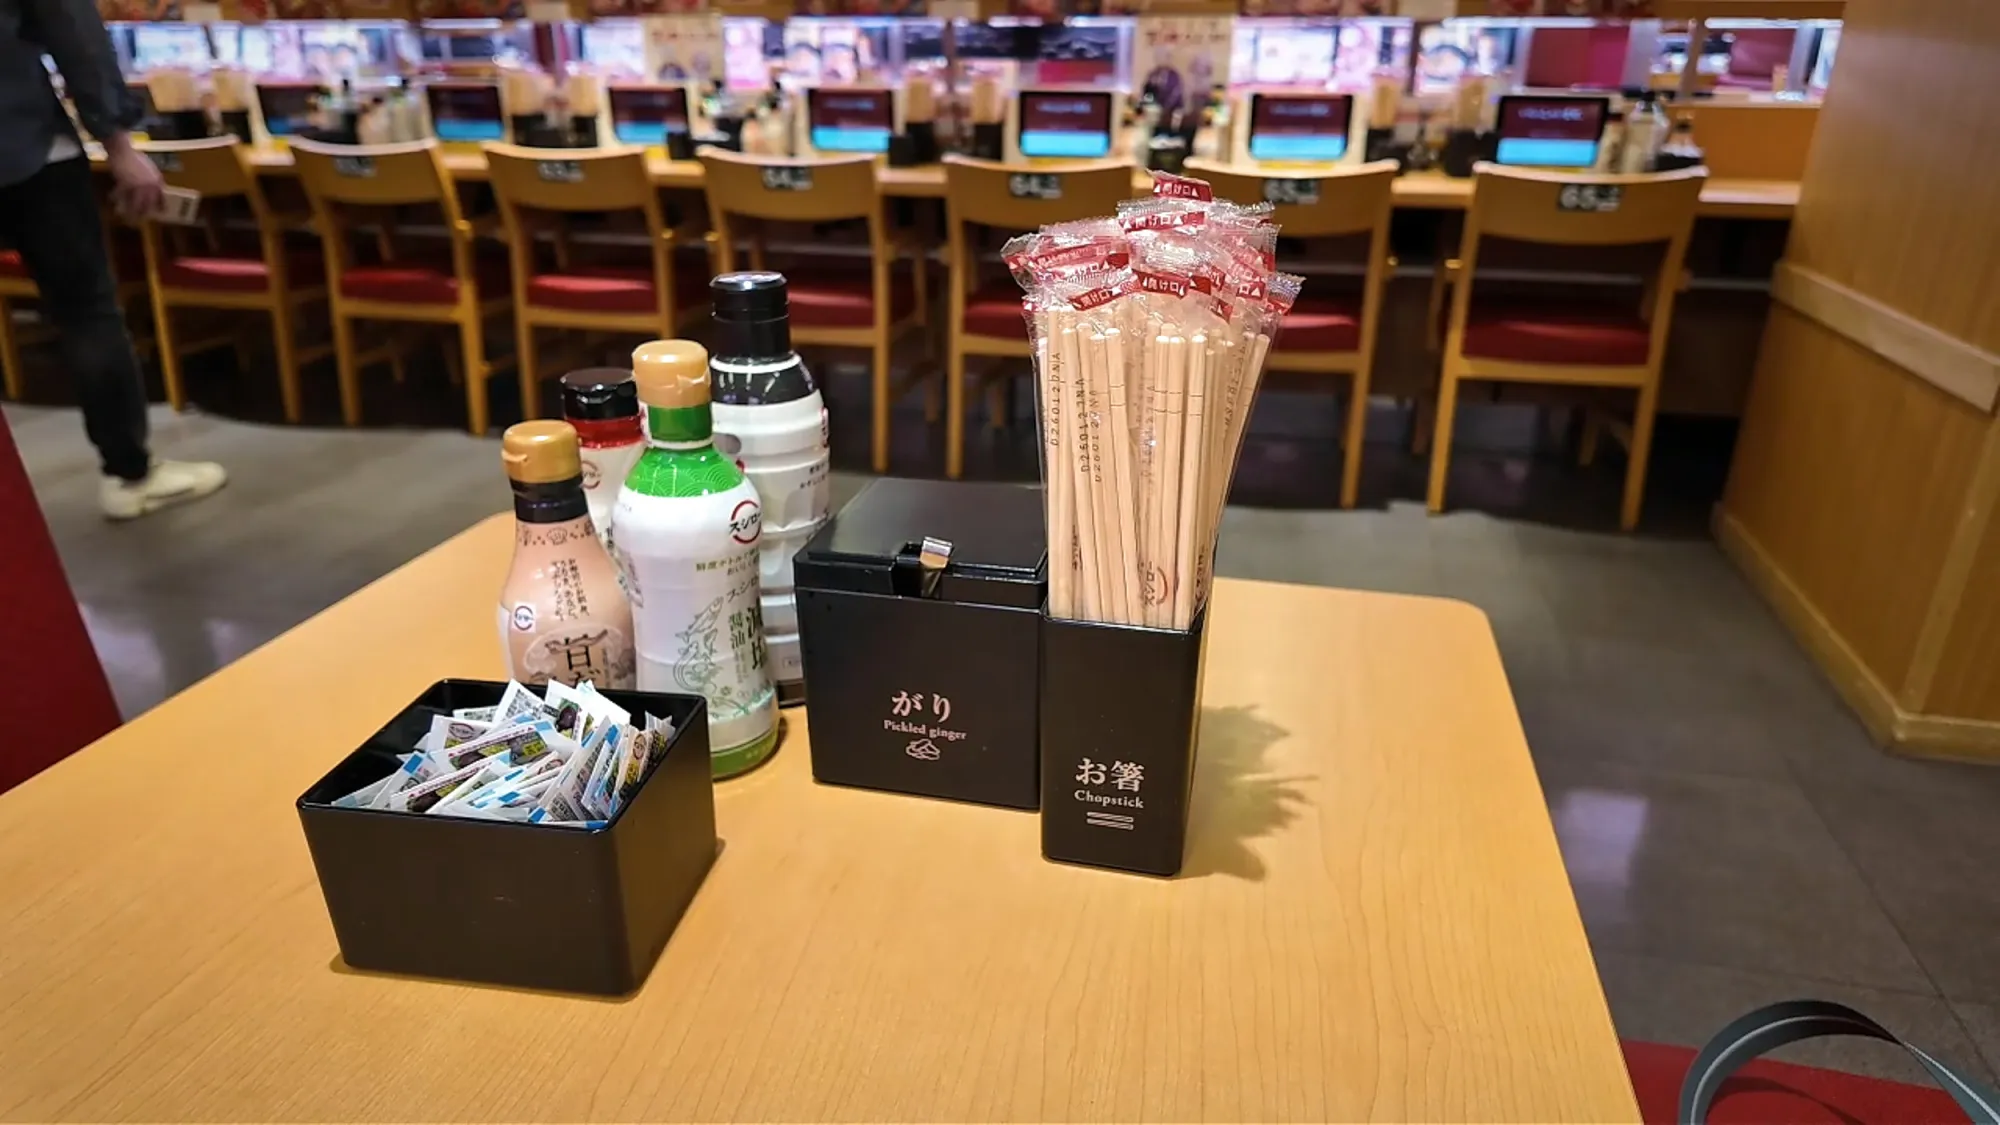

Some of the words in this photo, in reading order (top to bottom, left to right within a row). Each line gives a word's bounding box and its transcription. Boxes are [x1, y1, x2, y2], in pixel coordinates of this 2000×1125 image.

[891, 690, 951, 723] がり
[883, 719, 927, 735] Pickled
[929, 727, 967, 741] ginger
[1075, 757, 1145, 793] お箸
[1074, 789, 1144, 809] Chopstick
